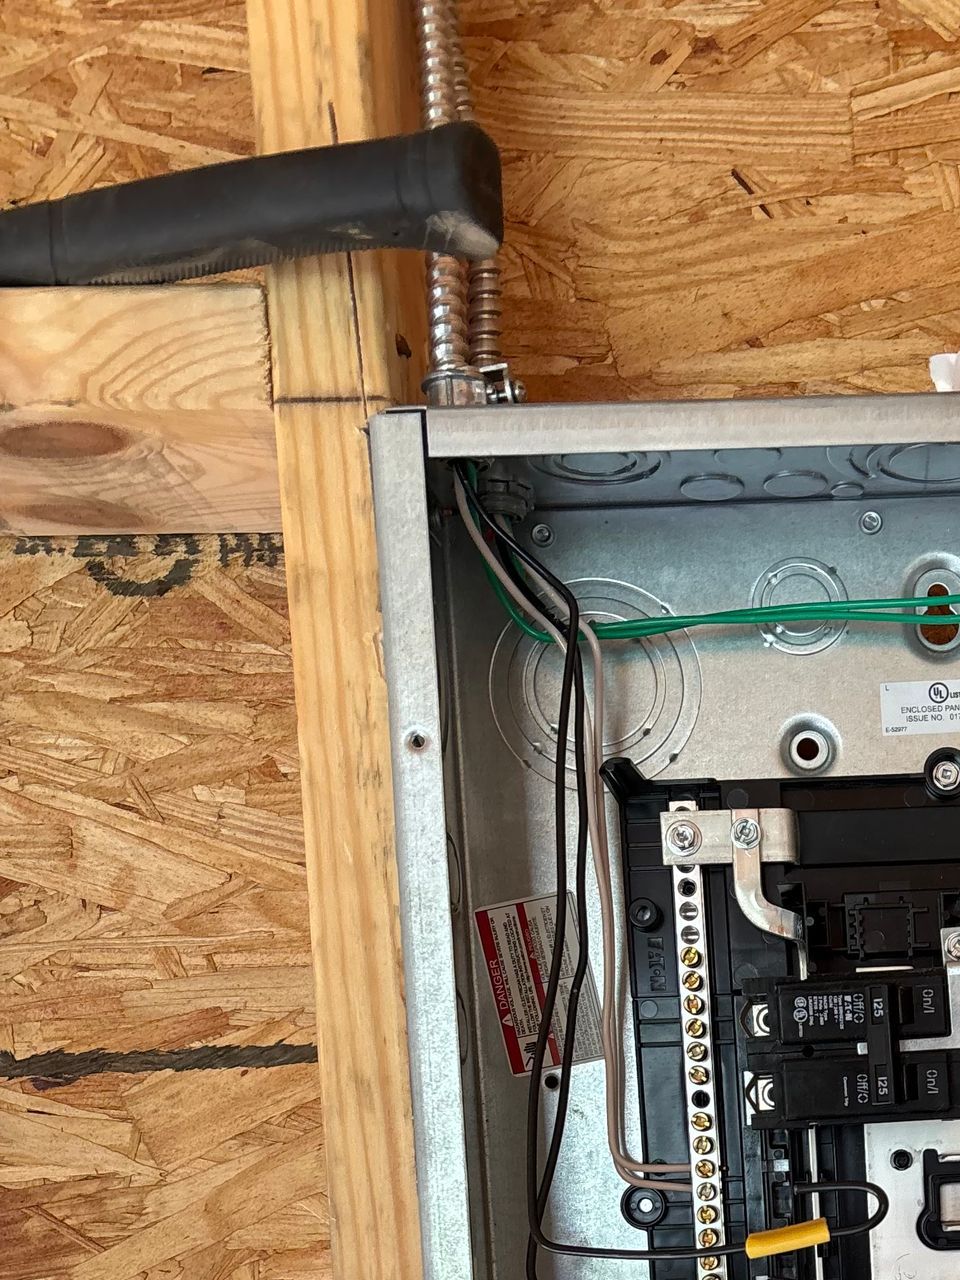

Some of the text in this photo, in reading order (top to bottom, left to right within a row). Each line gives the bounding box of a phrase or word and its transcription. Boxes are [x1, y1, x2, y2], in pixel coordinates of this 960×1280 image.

[901, 706, 943, 714] ENCLOSED
[931, 714, 944, 722] NO.
[488, 957, 509, 1010] DANGER
[873, 997, 883, 1017] 125
[877, 1076, 888, 1095] 125
